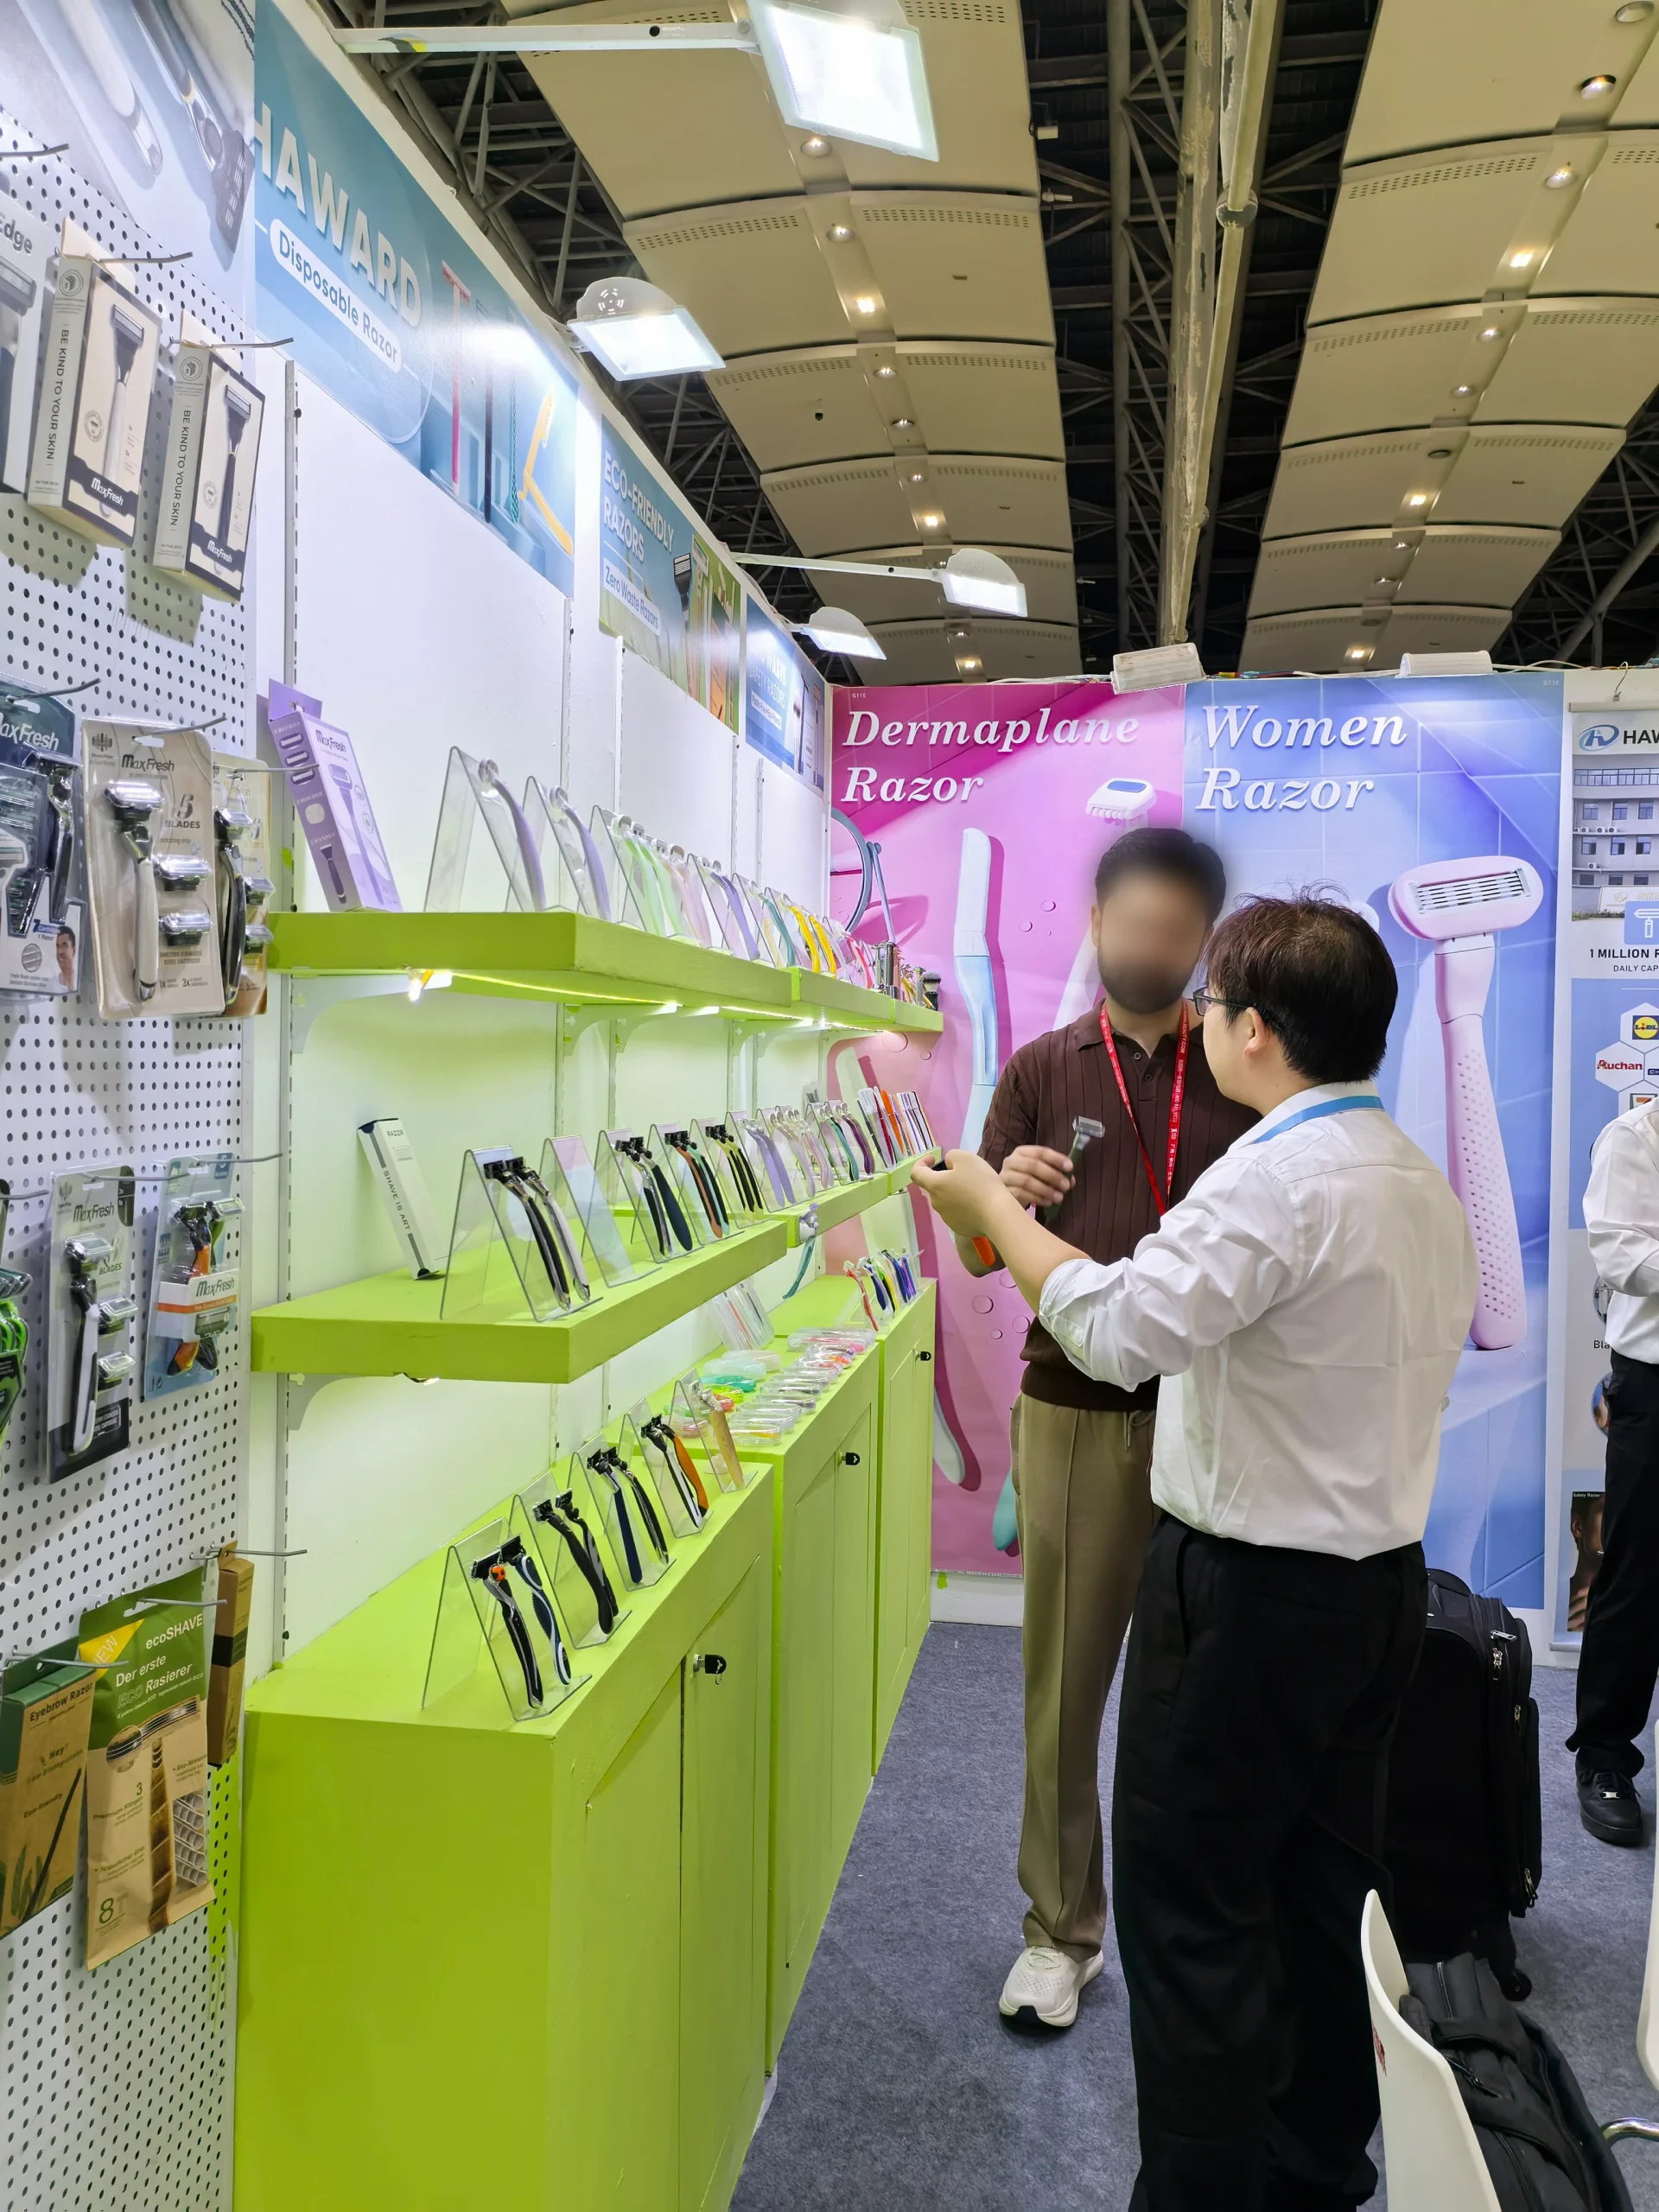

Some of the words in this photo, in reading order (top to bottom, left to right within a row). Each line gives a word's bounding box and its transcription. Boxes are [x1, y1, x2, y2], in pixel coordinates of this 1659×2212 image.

[0, 212, 33, 254] dge
[279, 229, 359, 327] Disposable
[363, 312, 398, 364] Razor
[60, 329, 70, 345] BE
[56, 348, 67, 378] KIND
[54, 380, 63, 395] TO
[49, 397, 62, 434] YOUR
[182, 410, 191, 423] BE
[46, 435, 57, 460] SKIN
[180, 426, 189, 452] KIND
[177, 454, 186, 468] TO
[91, 477, 124, 506] MaxFresh
[174, 471, 184, 499] YOUR
[170, 501, 180, 526] SKIN
[604, 449, 674, 553] ECO-FRIENDLY
[603, 494, 644, 563] RAZORS
[207, 539, 232, 563] MaxFresh
[606, 565, 620, 594] Zero
[621, 578, 639, 612] Waste
[640, 598, 658, 630] Razors
[842, 708, 1141, 753] Dermaplane
[1202, 704, 1408, 749] Women
[315, 730, 346, 753] MaxFresh
[121, 753, 175, 772] MaxFresh
[840, 766, 983, 803] Razor
[1194, 767, 1375, 811] Razor
[165, 820, 200, 829] BLADES
[1590, 949, 1593, 958] 1
[1598, 949, 1649, 958] MILLION
[1597, 1059, 1643, 1071] Auchan
[73, 1202, 114, 1224] MaxFresh
[383, 1170, 399, 1199] SHAVE
[395, 1201, 403, 1211] IS
[400, 1213, 410, 1230] ART
[99, 1263, 123, 1275] BLADES
[196, 1276, 235, 1297] MaxFresh
[145, 1612, 204, 1649] ecoSHAVE
[116, 1669, 137, 1688] Der
[139, 1655, 167, 1676] erste
[145, 1663, 193, 1694] Rasierer
[30, 1696, 68, 1722] Eyebrow
[70, 1681, 93, 1700] Razor
[48, 1742, 69, 1760] Hey!
[137, 1782, 143, 1796] 3
[23, 1792, 63, 1820] Eco-friendly
[92, 1808, 123, 1821] Premium
[99, 1897, 114, 1924] 8
